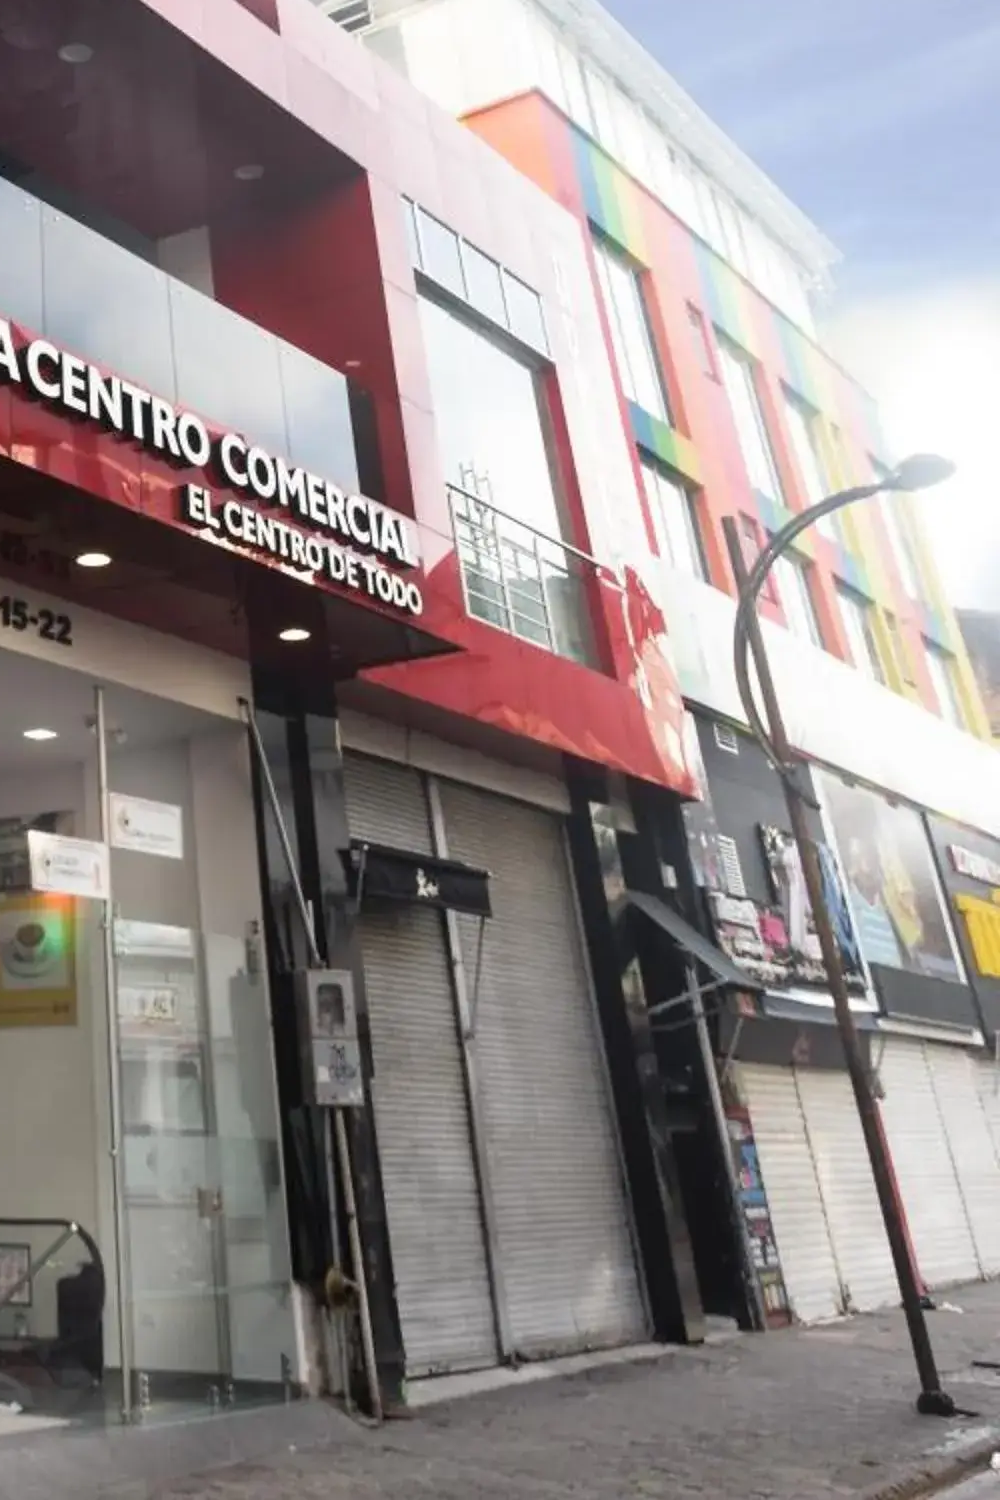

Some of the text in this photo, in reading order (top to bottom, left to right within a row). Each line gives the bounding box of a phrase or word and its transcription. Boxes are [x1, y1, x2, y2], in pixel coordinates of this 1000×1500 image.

[26, 339, 210, 466] CENTRO
[220, 433, 419, 568] COMERCIAL
[188, 483, 423, 616] EL CENTRO DE TODO
